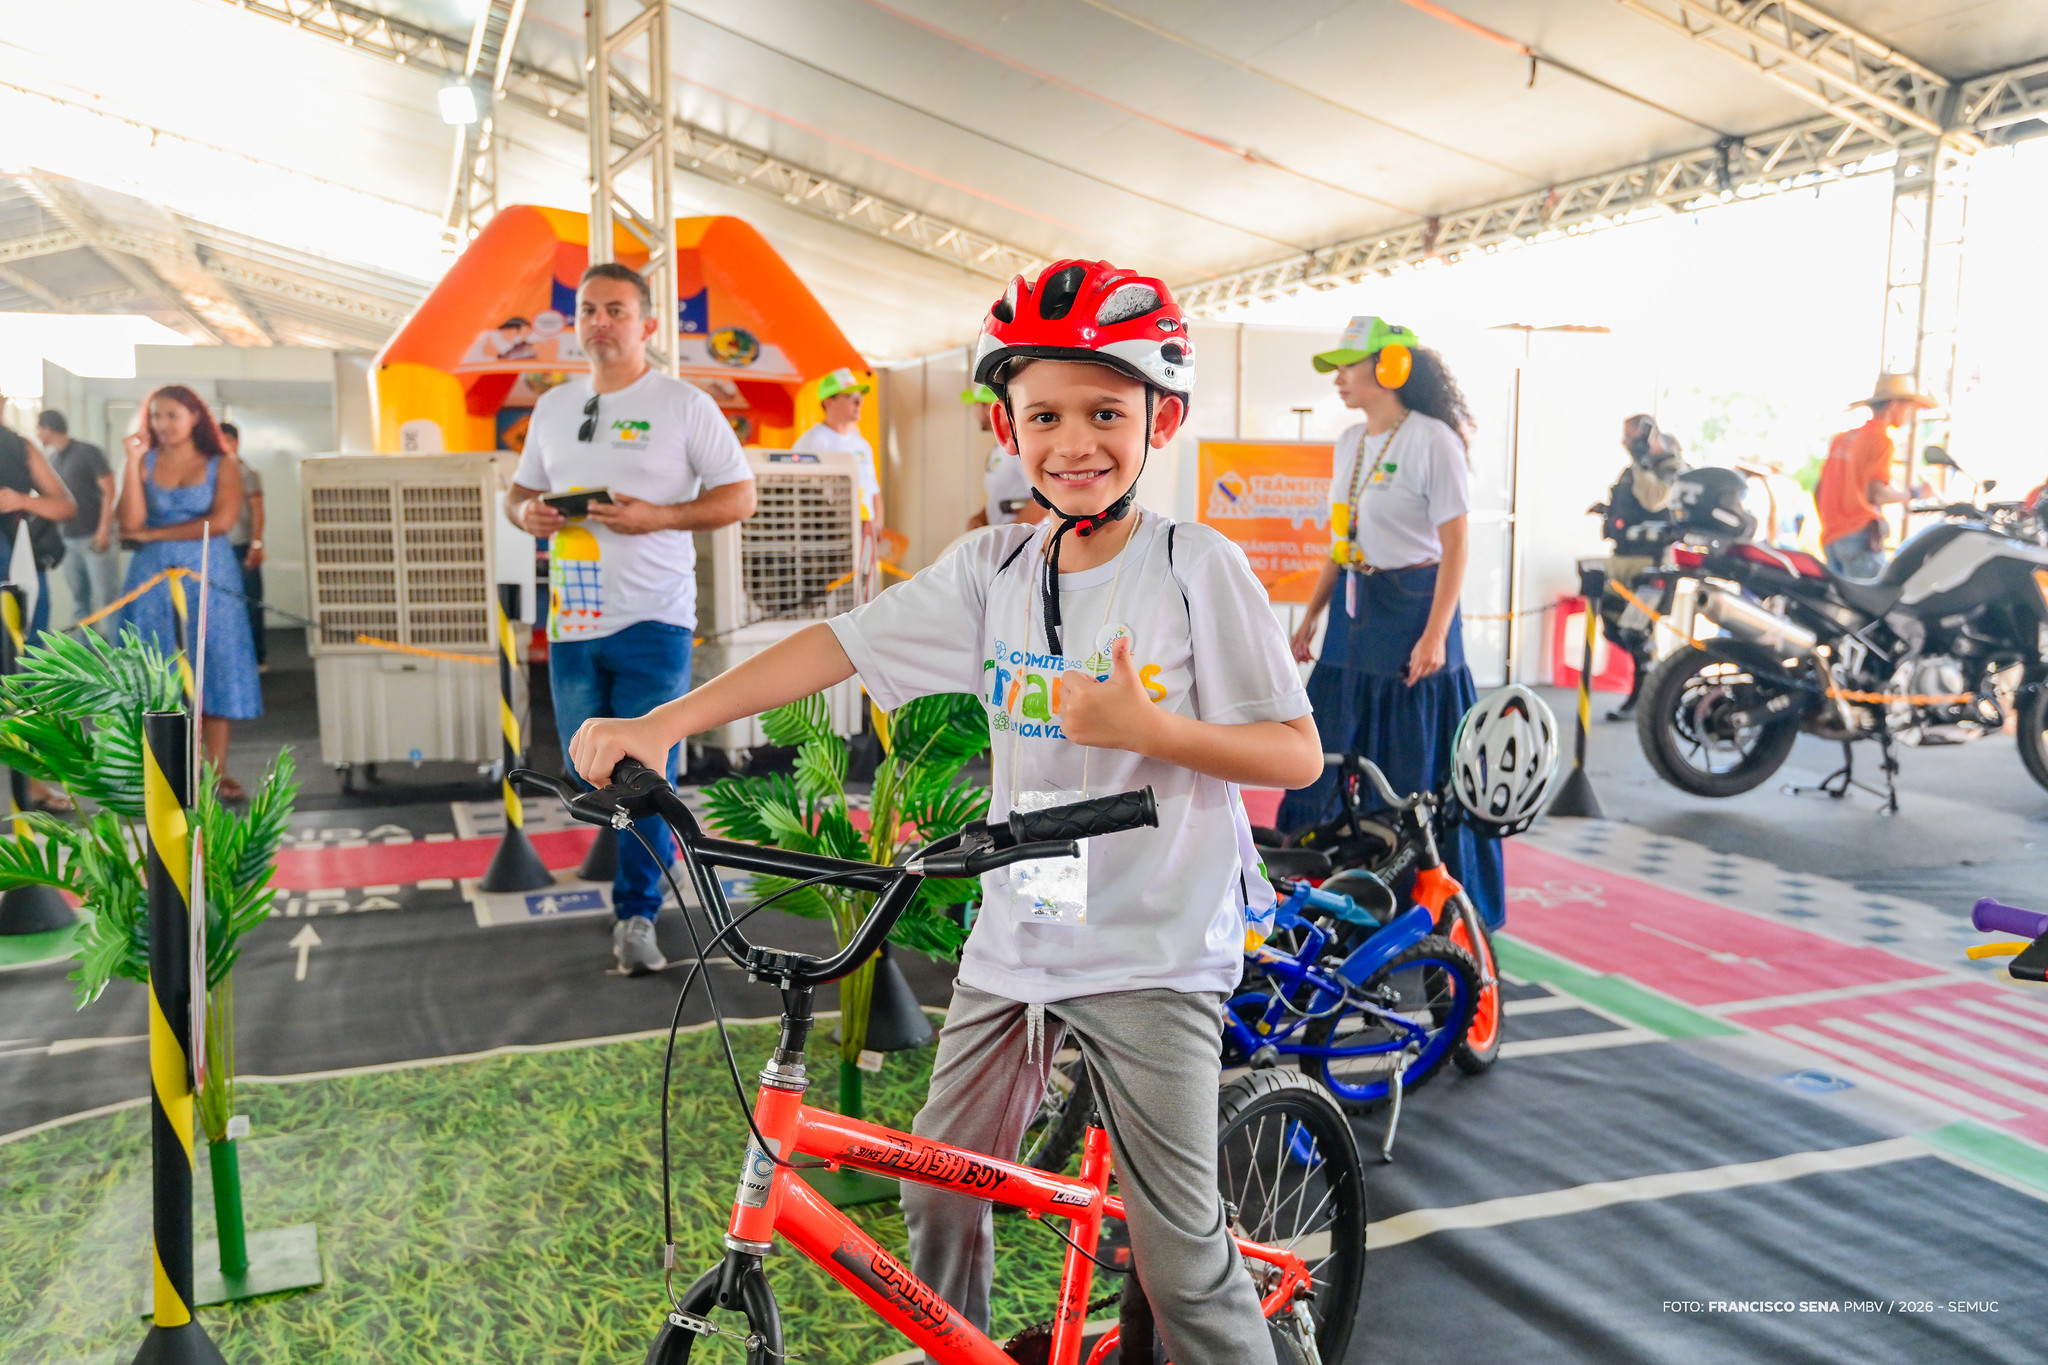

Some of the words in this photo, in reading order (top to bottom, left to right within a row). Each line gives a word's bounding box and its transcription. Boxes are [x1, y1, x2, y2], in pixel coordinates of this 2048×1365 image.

[1253, 475, 1331, 492] TRÂNSITO
[1253, 493, 1318, 507] SEGURO
[1239, 539, 1300, 556] RÂNSITO,
[1281, 558, 1322, 572] SALVA
[1064, 660, 1082, 669] DAS
[856, 1147, 882, 1161] BIKE
[881, 1136, 965, 1182] FLASH
[1052, 1190, 1092, 1206] CROSS
[871, 1245, 949, 1325] CAIRU
